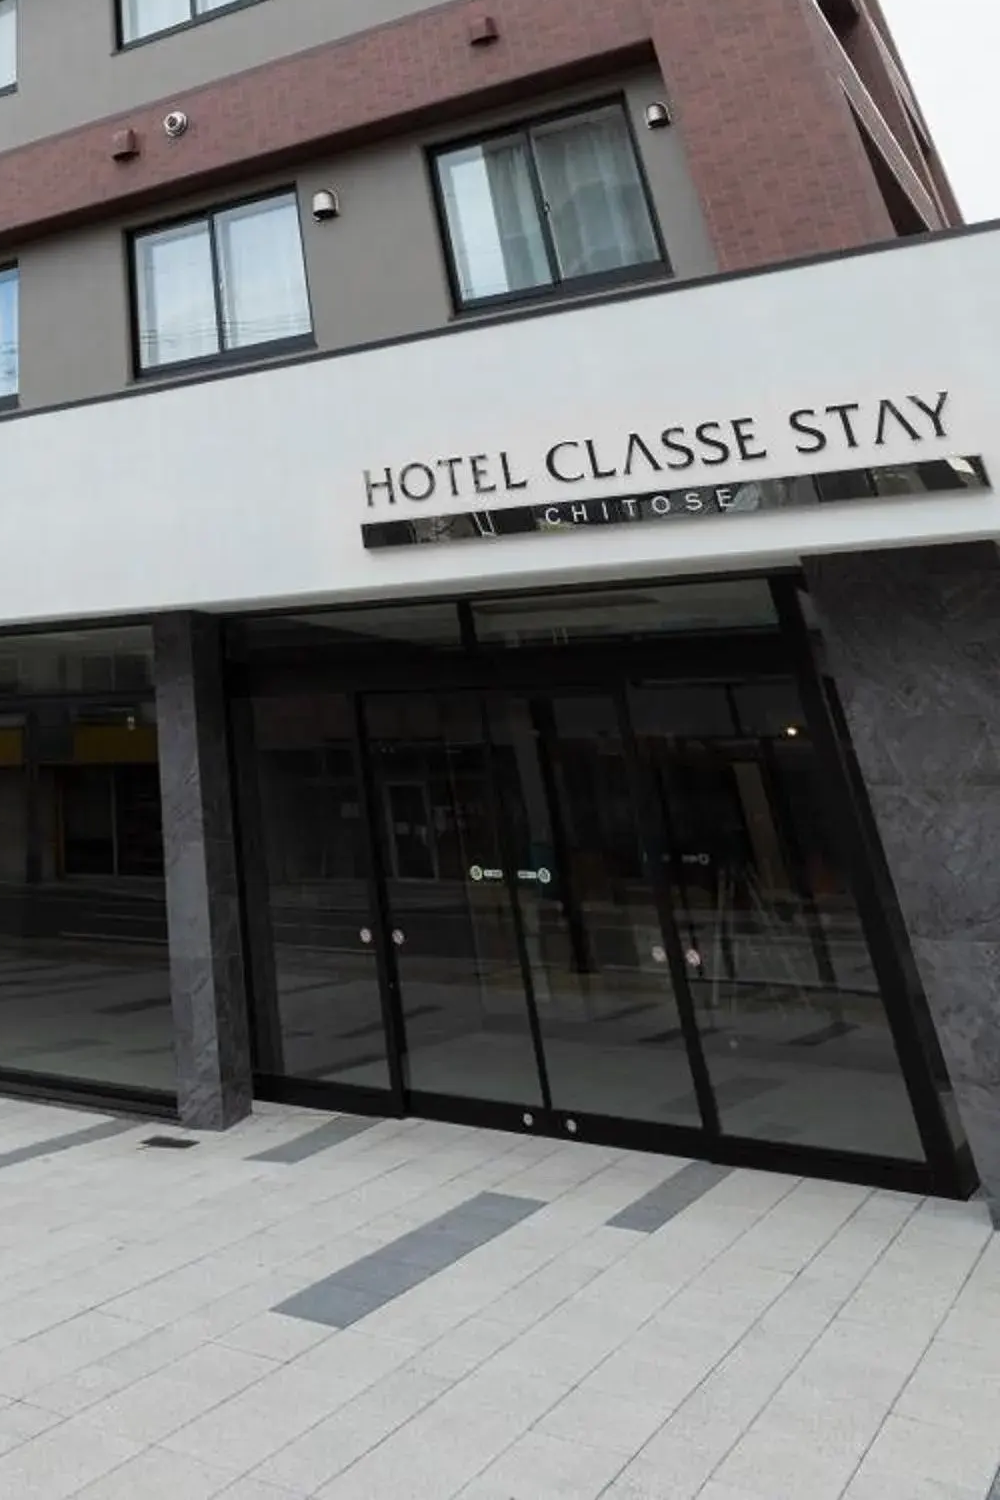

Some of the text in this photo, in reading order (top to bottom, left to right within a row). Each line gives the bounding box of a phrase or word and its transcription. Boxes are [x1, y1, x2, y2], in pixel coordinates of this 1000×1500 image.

[362, 391, 949, 506] HOTEL CLASSE STAY
[545, 488, 734, 525] CHITOSE
